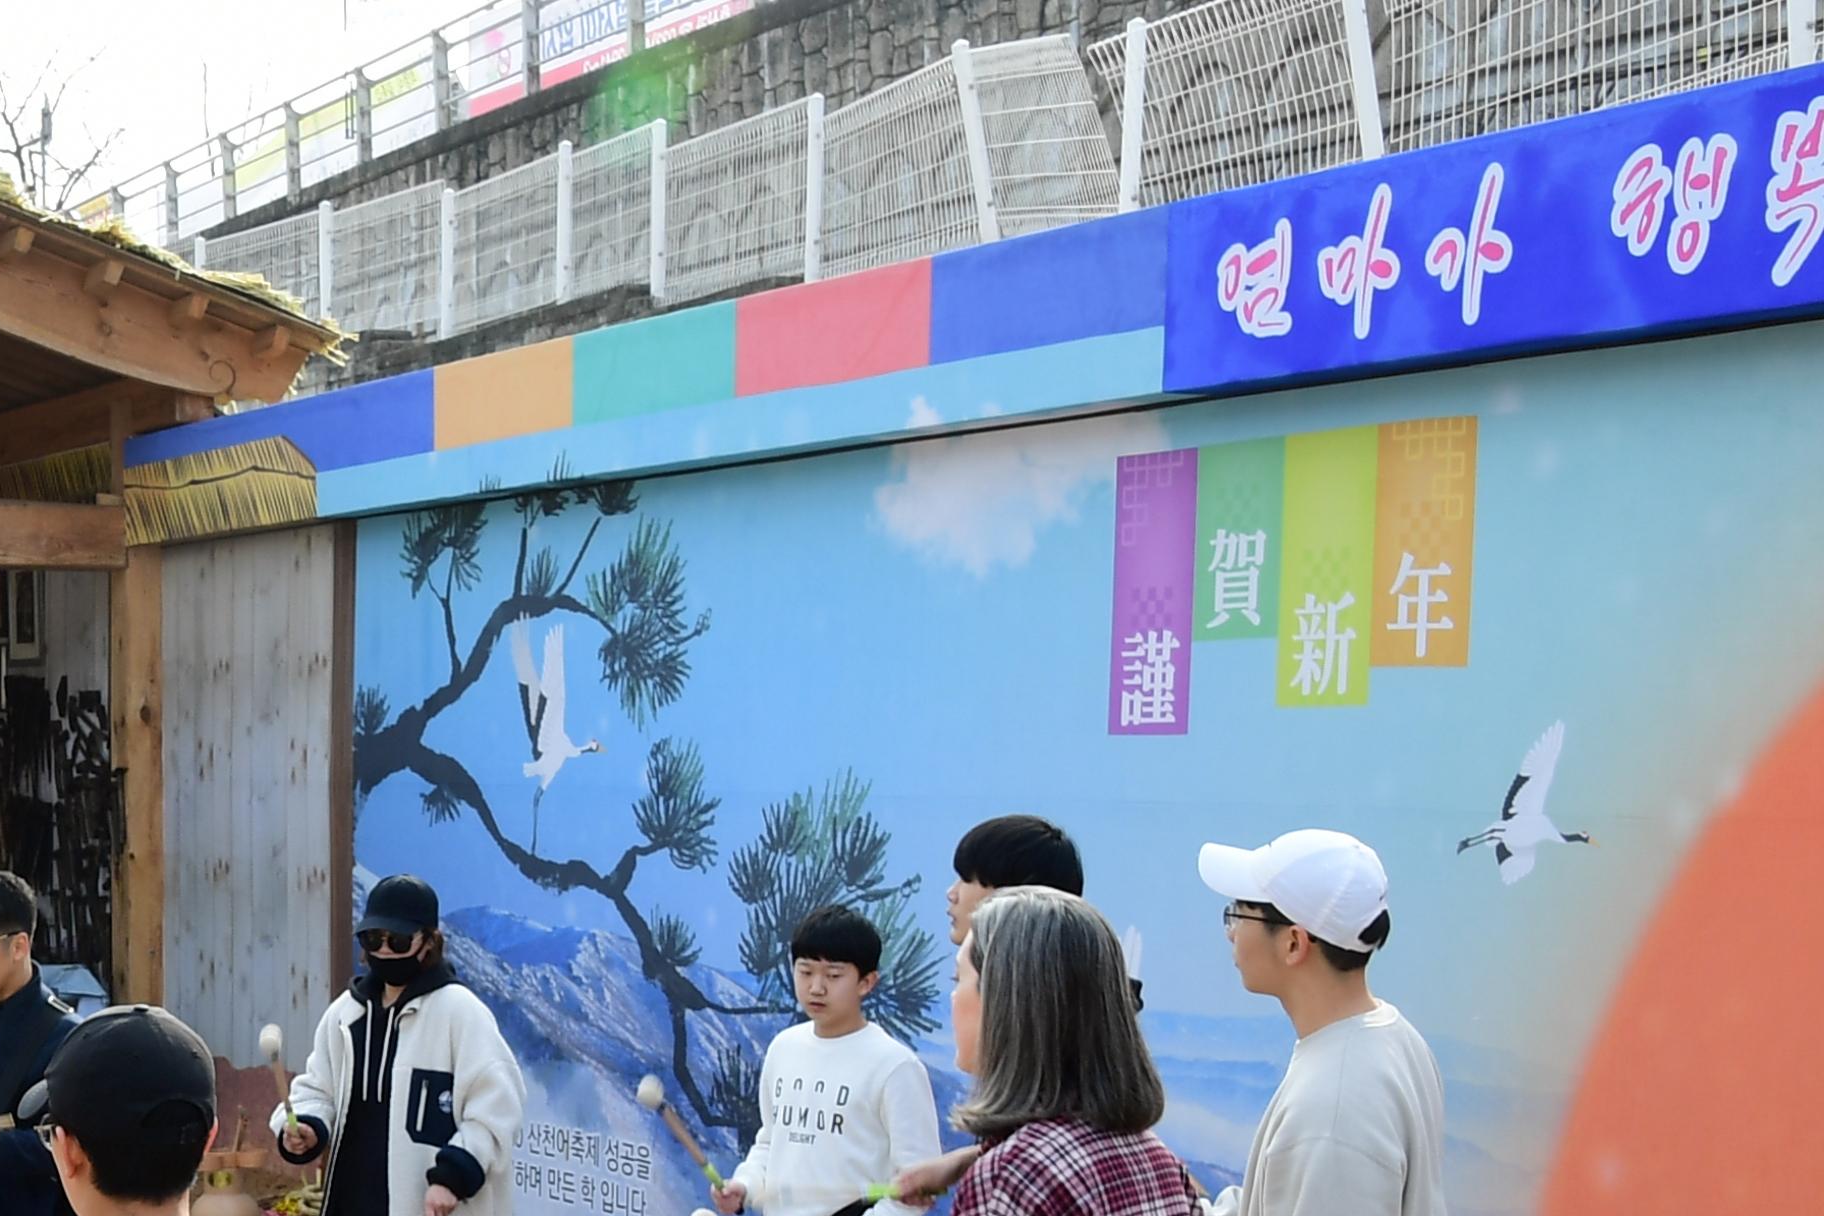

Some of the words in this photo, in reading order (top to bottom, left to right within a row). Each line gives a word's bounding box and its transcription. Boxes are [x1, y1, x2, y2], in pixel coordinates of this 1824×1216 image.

[527, 1123, 600, 1168] 산천어축제
[605, 1139, 651, 1181] 성공을
[513, 1160, 543, 1197] 하며
[547, 1168, 576, 1204] 만든
[581, 1175, 596, 1209] 학
